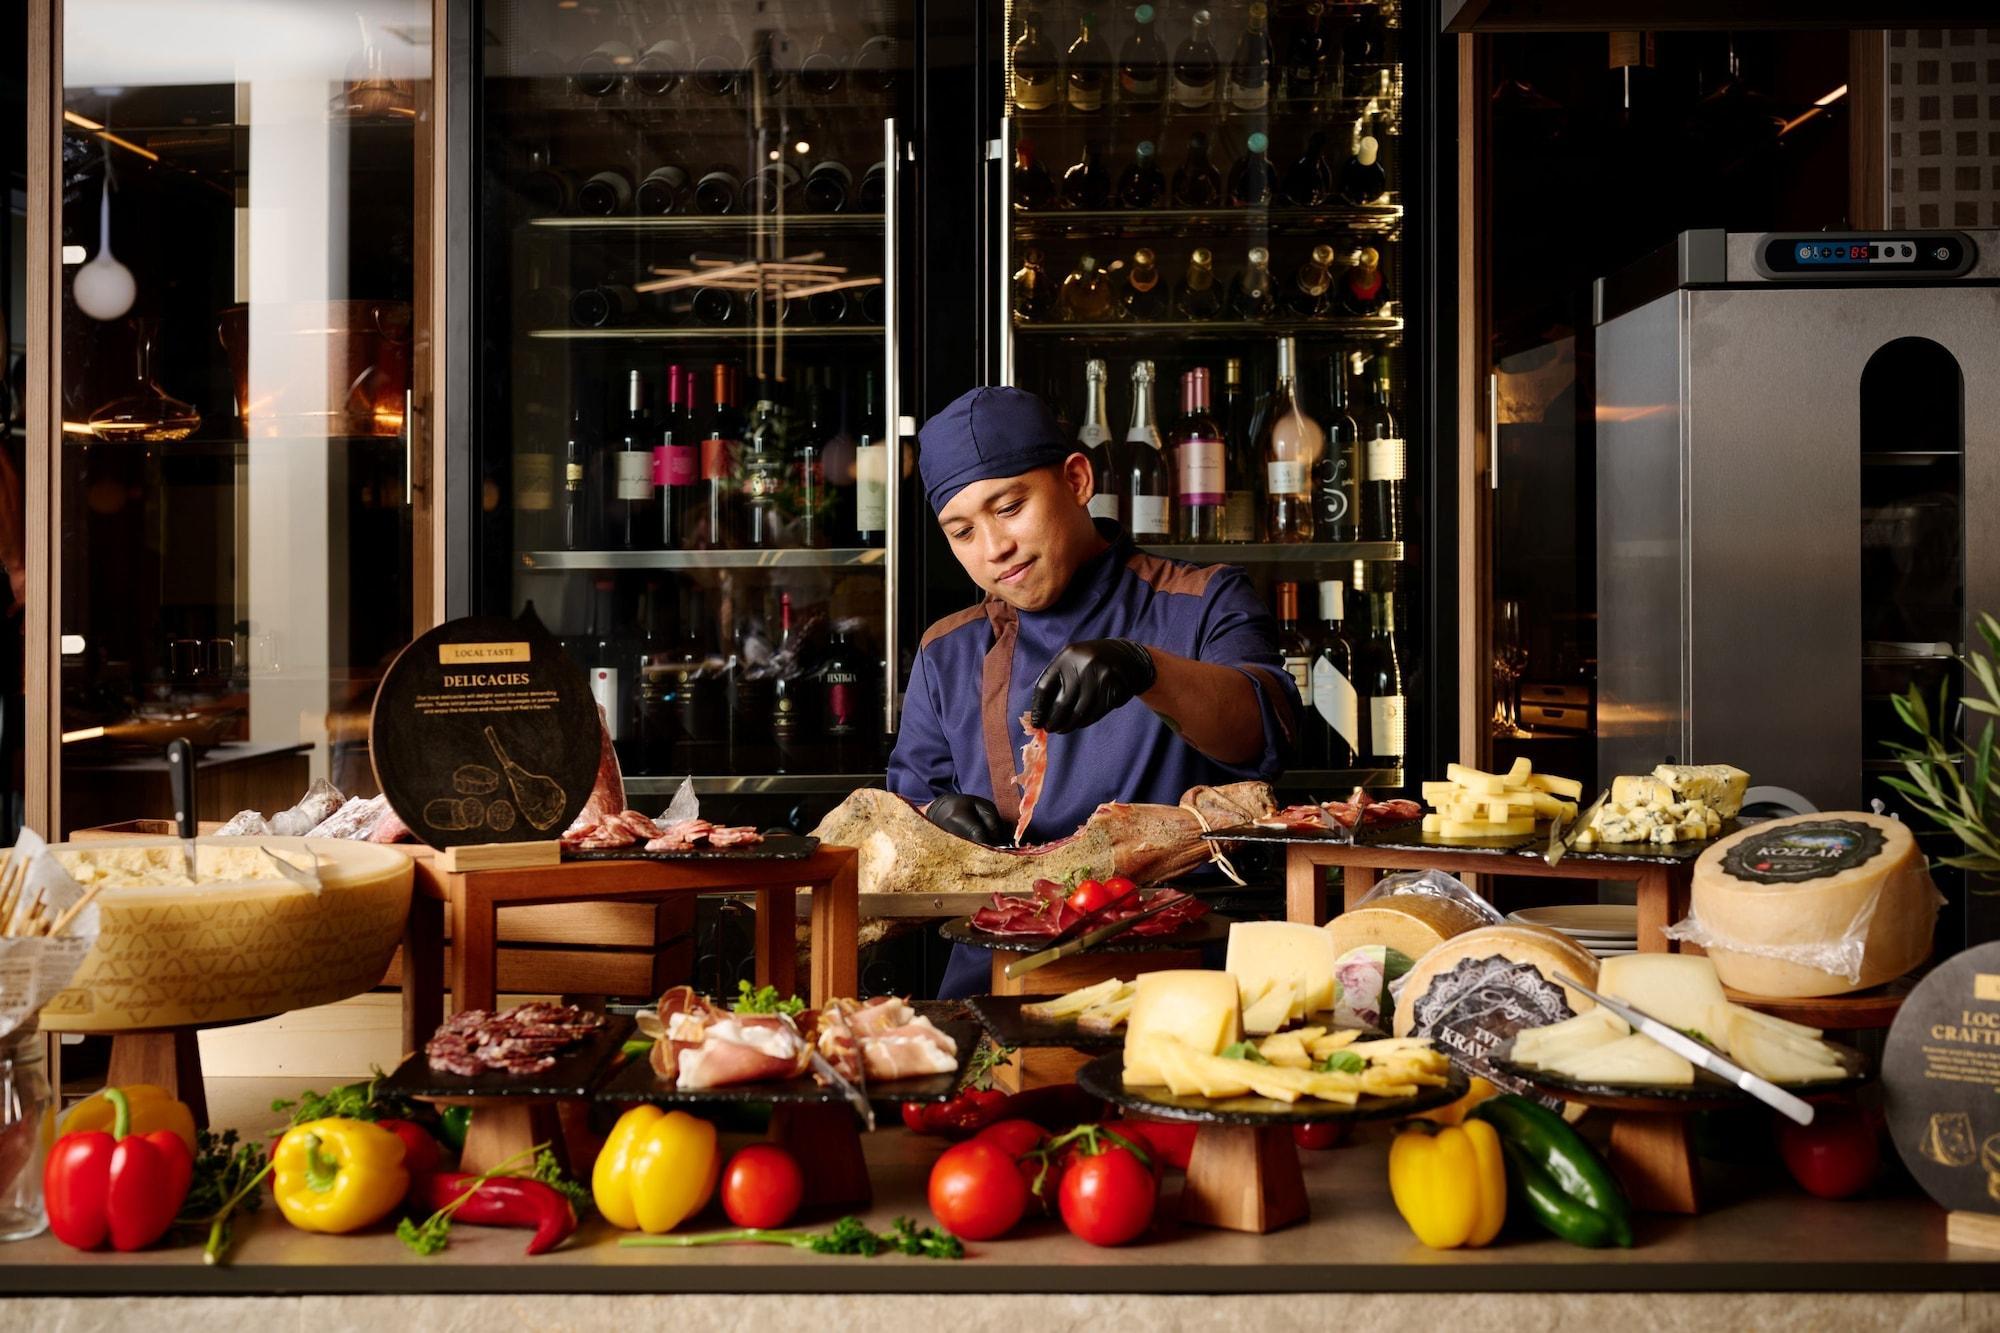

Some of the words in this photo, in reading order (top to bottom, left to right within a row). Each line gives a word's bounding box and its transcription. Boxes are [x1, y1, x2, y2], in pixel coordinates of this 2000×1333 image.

[1851, 247, 1868, 258] 85
[455, 649, 484, 658] LOCAL
[487, 648, 514, 657] TASTE
[443, 673, 530, 688] DELICACIES
[1756, 847, 1843, 859] KOZLAR
[1439, 1026, 1490, 1063] KRAV
